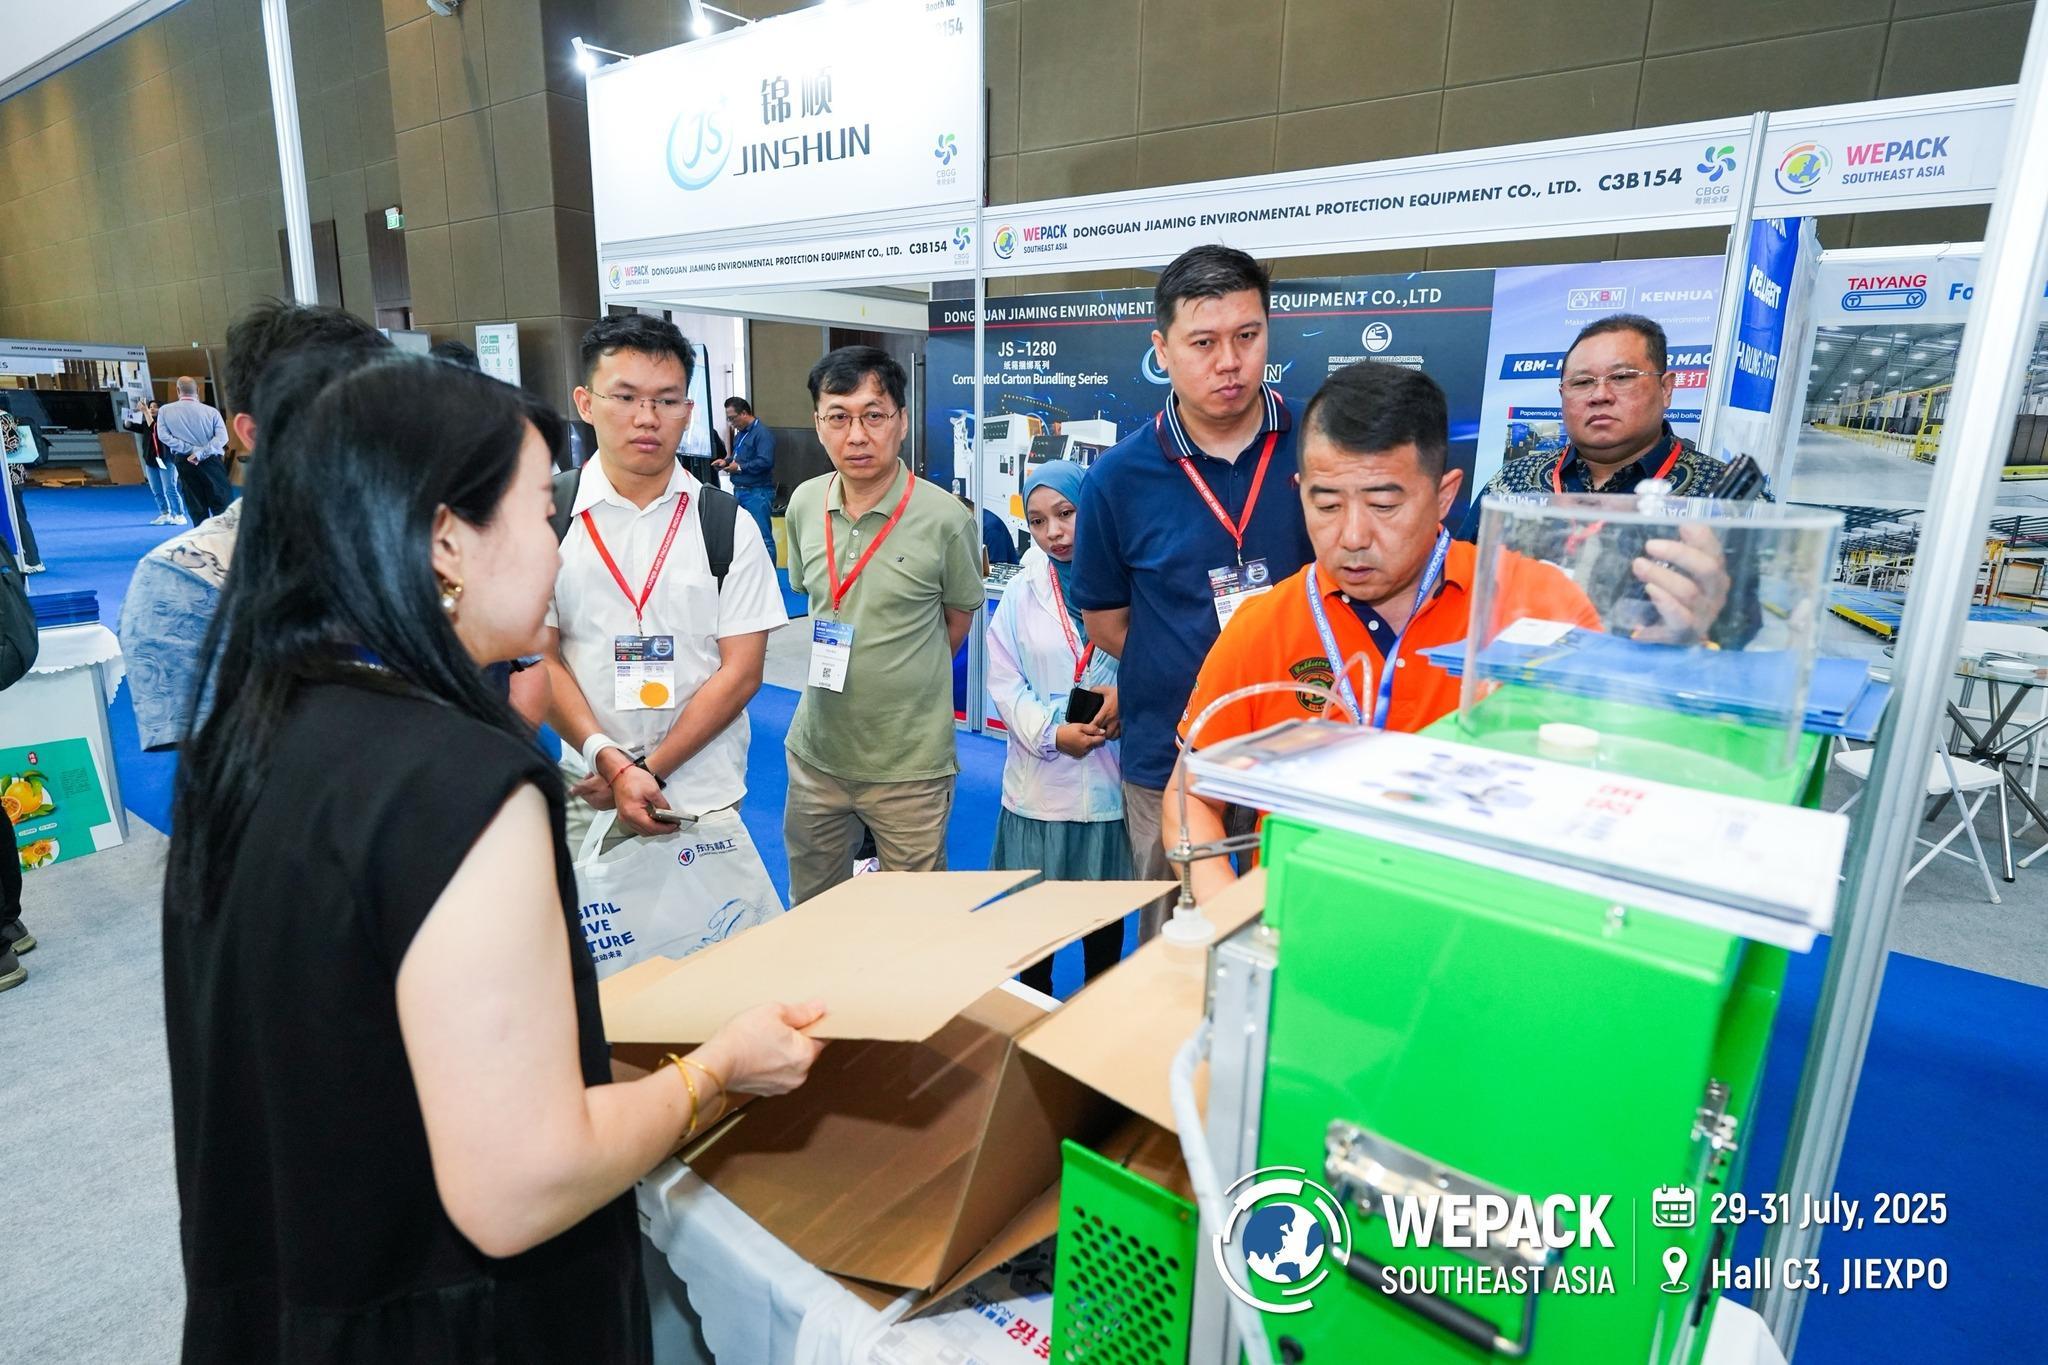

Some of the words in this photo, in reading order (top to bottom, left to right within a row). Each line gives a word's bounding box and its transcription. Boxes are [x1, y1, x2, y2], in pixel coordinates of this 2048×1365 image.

[732, 123, 870, 176] JINSHUN
[1846, 135, 1951, 167] WEPACK
[1598, 168, 1682, 191] C3B154
[1841, 167, 1914, 185] SOUTHEAST
[1916, 164, 1946, 179] ASIA
[1695, 185, 1730, 196] CBGG
[1073, 221, 1141, 238] DONGGUAN
[1144, 216, 1196, 231] JIAMING
[1200, 204, 1311, 227] ENVIRONMENTAL
[1315, 196, 1404, 216] PROTECTION
[1409, 186, 1502, 208] EQUIPMENT
[1507, 184, 1541, 198] CO.,
[1548, 180, 1582, 195] LTD.
[1023, 223, 1068, 242] WEPACK
[909, 240, 948, 255] C3B154
[1023, 243, 1054, 254] SOUTHEAST
[1055, 242, 1068, 252] ASIA
[652, 267, 688, 277] DONGGUAN
[689, 263, 716, 273] JIAMING
[717, 257, 774, 271] ENVIRONMENTAL
[776, 253, 820, 266] PROTECTION
[821, 249, 866, 262] EQUIPMENT
[867, 248, 884, 259] CO.,
[886, 246, 902, 256] LTD.
[624, 265, 649, 277] WEPACK
[1848, 274, 1928, 290] TAIYANG
[1589, 290, 1623, 302] KBM
[1641, 290, 1713, 302] KENHUA
[1948, 282, 1974, 301] Fo
[944, 308, 1006, 323] DONGUAN
[1008, 305, 1057, 320] JIAMING
[1060, 300, 1156, 318] ENVIRONMENT
[1270, 290, 1368, 311] EQUIPMENT
[1371, 287, 1442, 309] CO.,LTD
[998, 341, 1014, 357] JS
[952, 372, 1000, 385] Corruted
[1001, 373, 1032, 385] Carton
[1033, 372, 1076, 388] Bundling
[1077, 371, 1109, 385] Series
[1310, 594, 1327, 630] INDUSTRY
[695, 838, 737, 853] 东方精工
